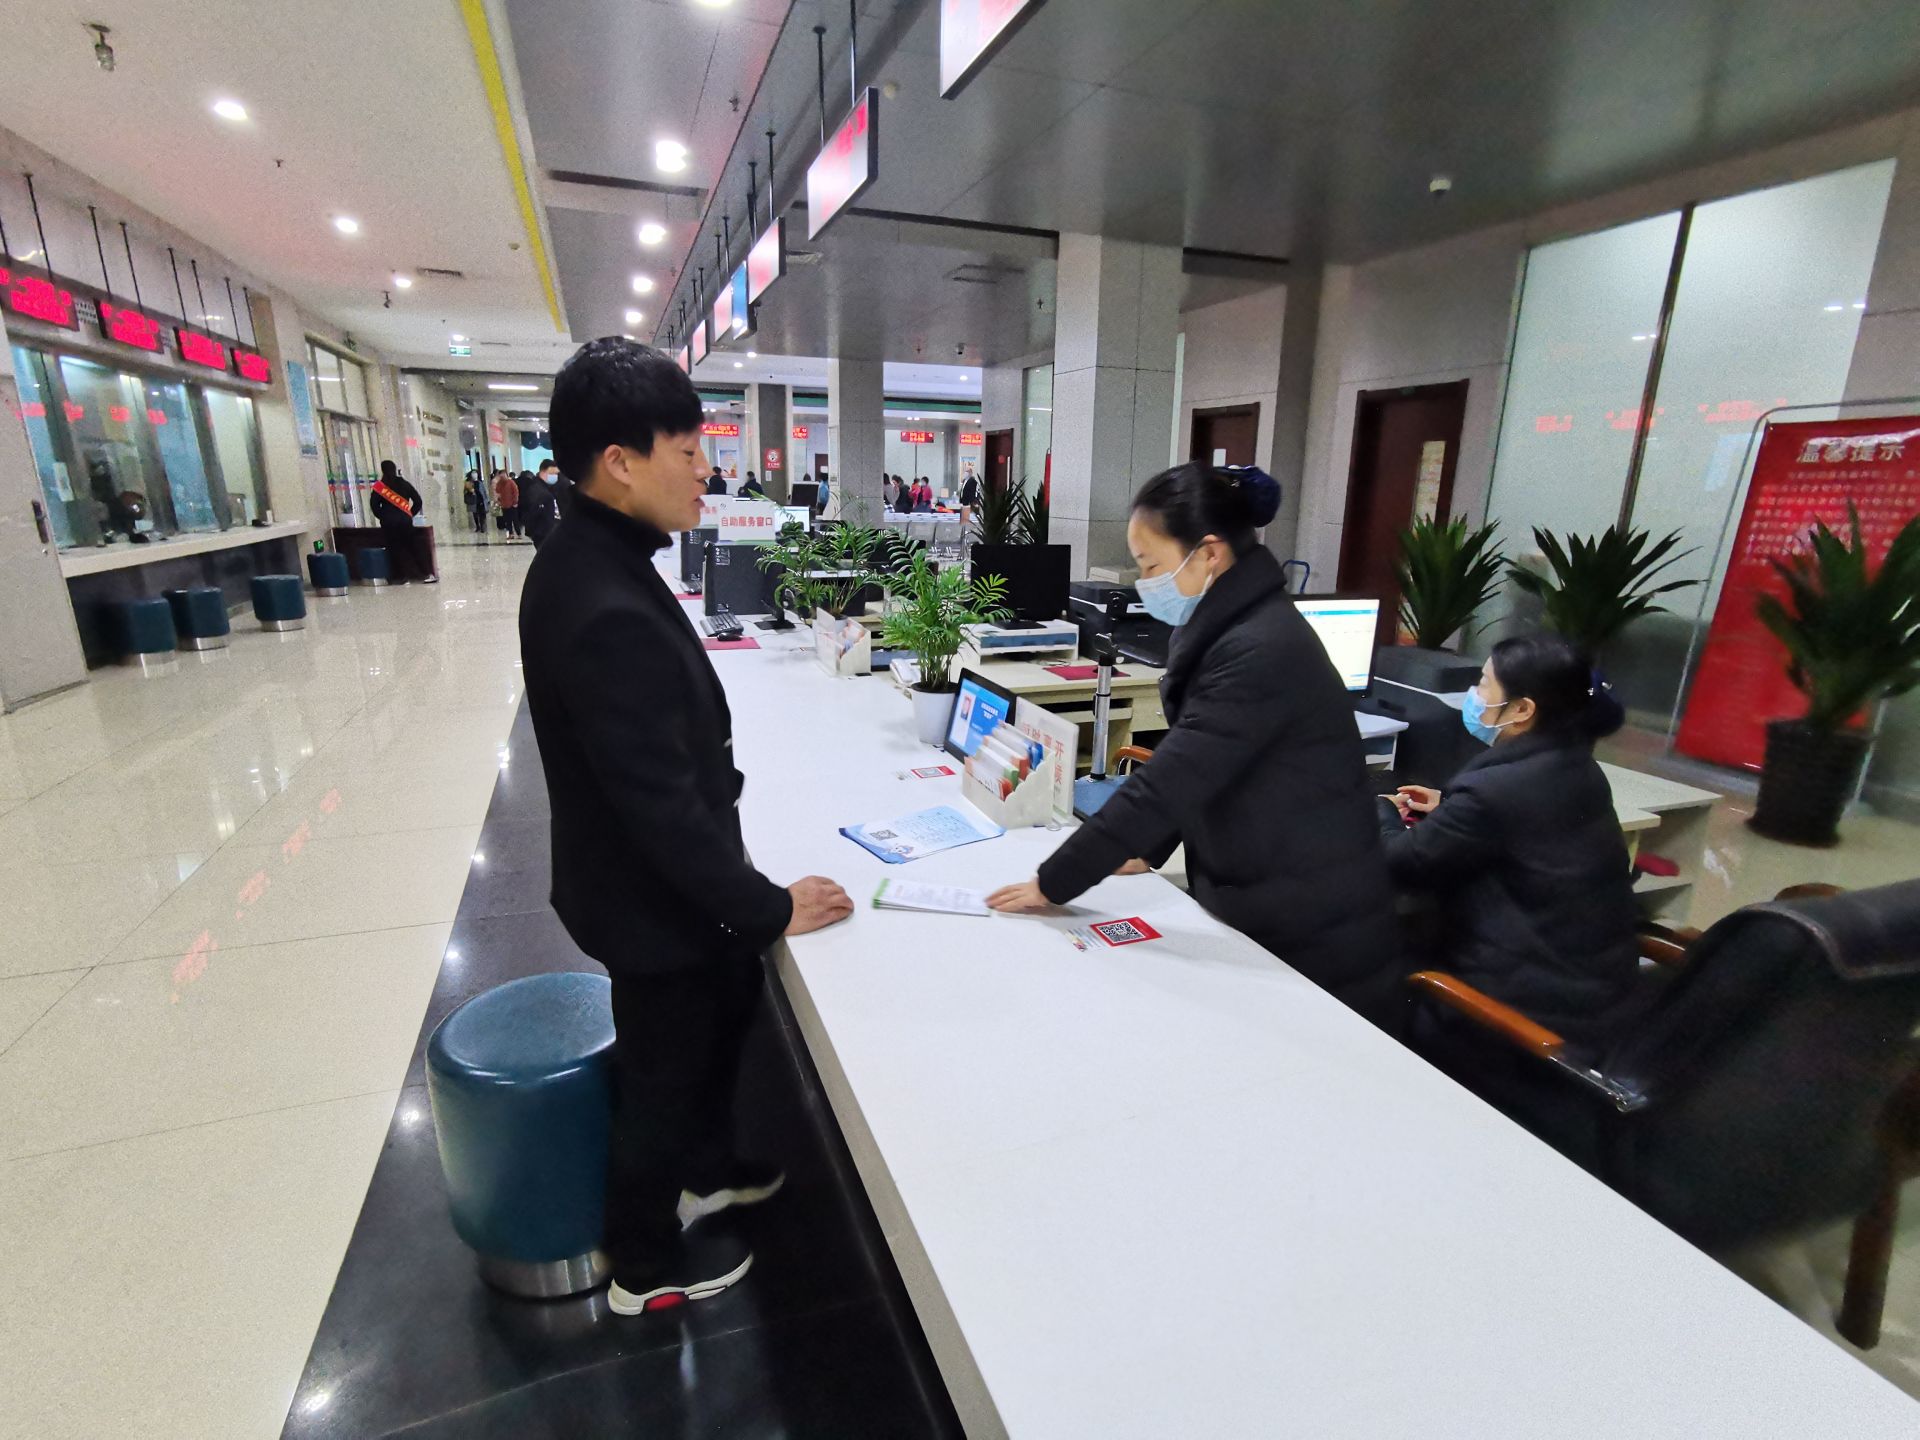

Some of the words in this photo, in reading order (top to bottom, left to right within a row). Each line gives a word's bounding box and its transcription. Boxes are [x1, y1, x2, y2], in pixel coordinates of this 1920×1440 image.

[1796, 438, 1905, 463] 温馨提示
[721, 516, 773, 527] 自助服务窗口
